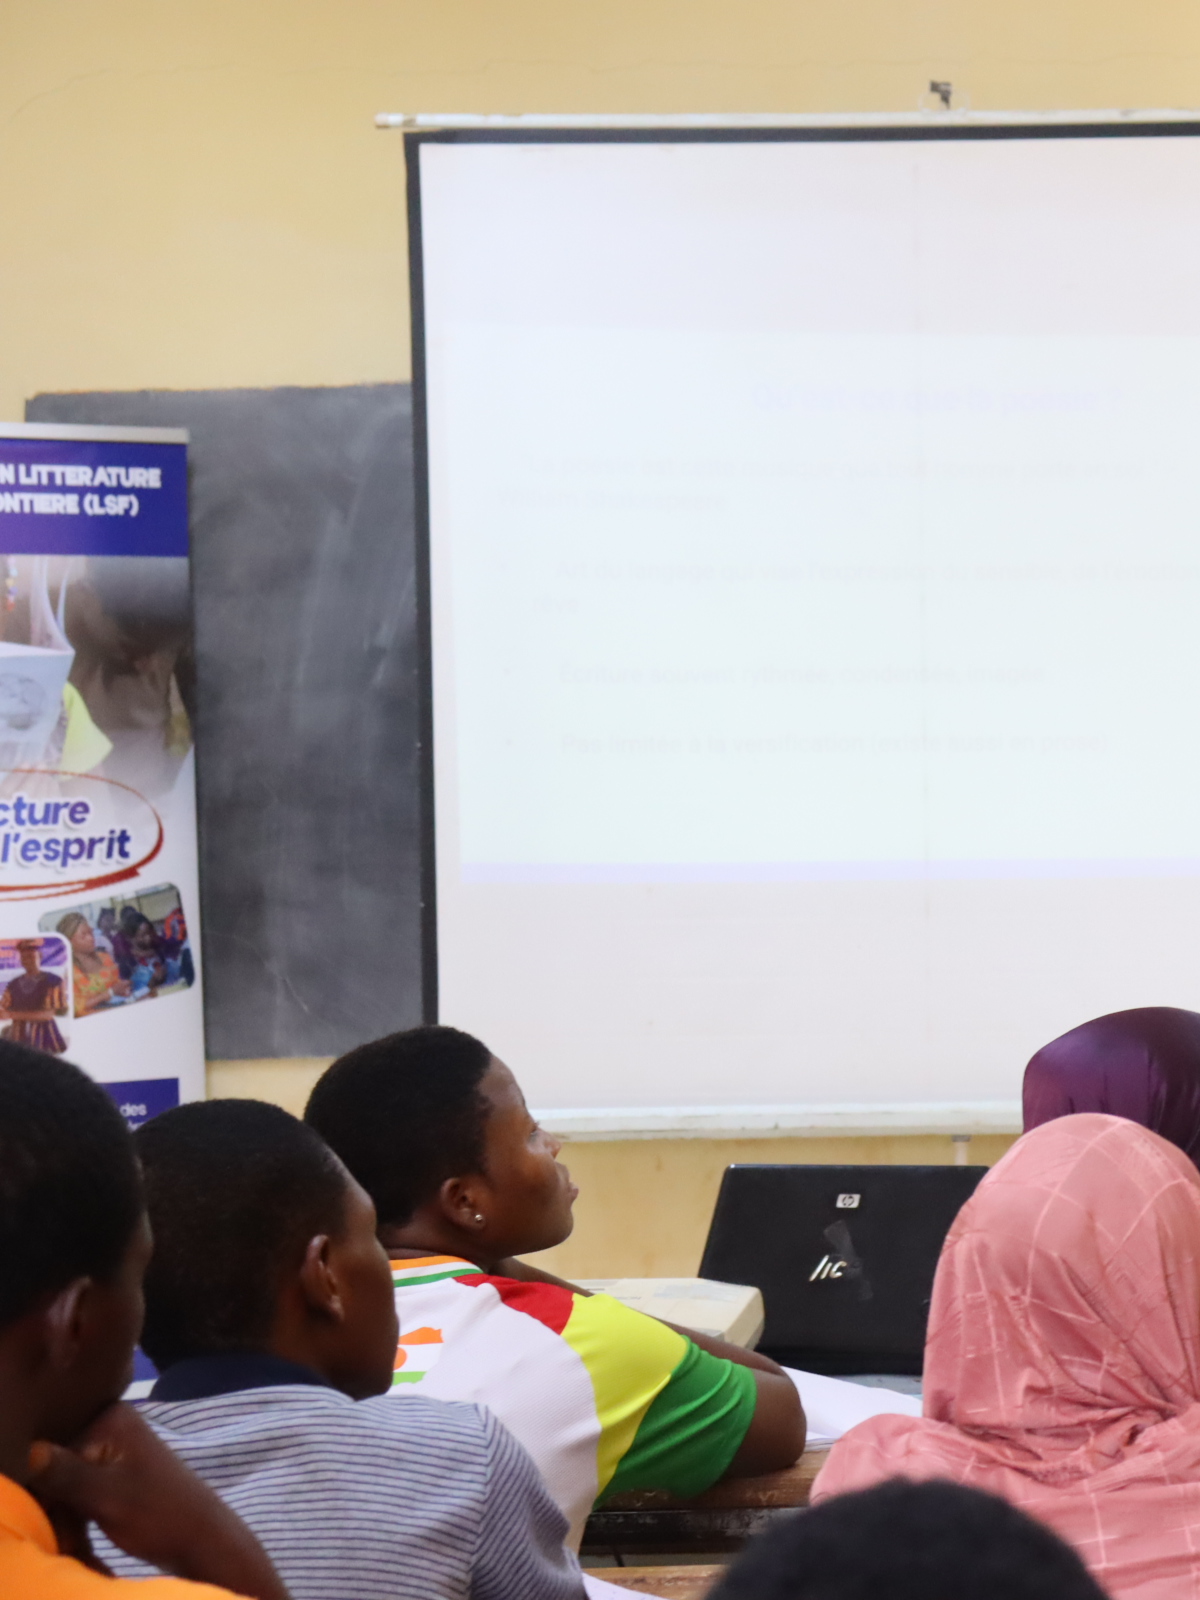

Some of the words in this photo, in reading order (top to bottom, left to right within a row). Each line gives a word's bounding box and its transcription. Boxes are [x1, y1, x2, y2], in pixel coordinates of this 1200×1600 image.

[19, 462, 162, 489] LITTERATURE
[83, 492, 140, 517] (LSF)
[1, 829, 131, 868] l'esprit
[120, 1103, 147, 1117] des
